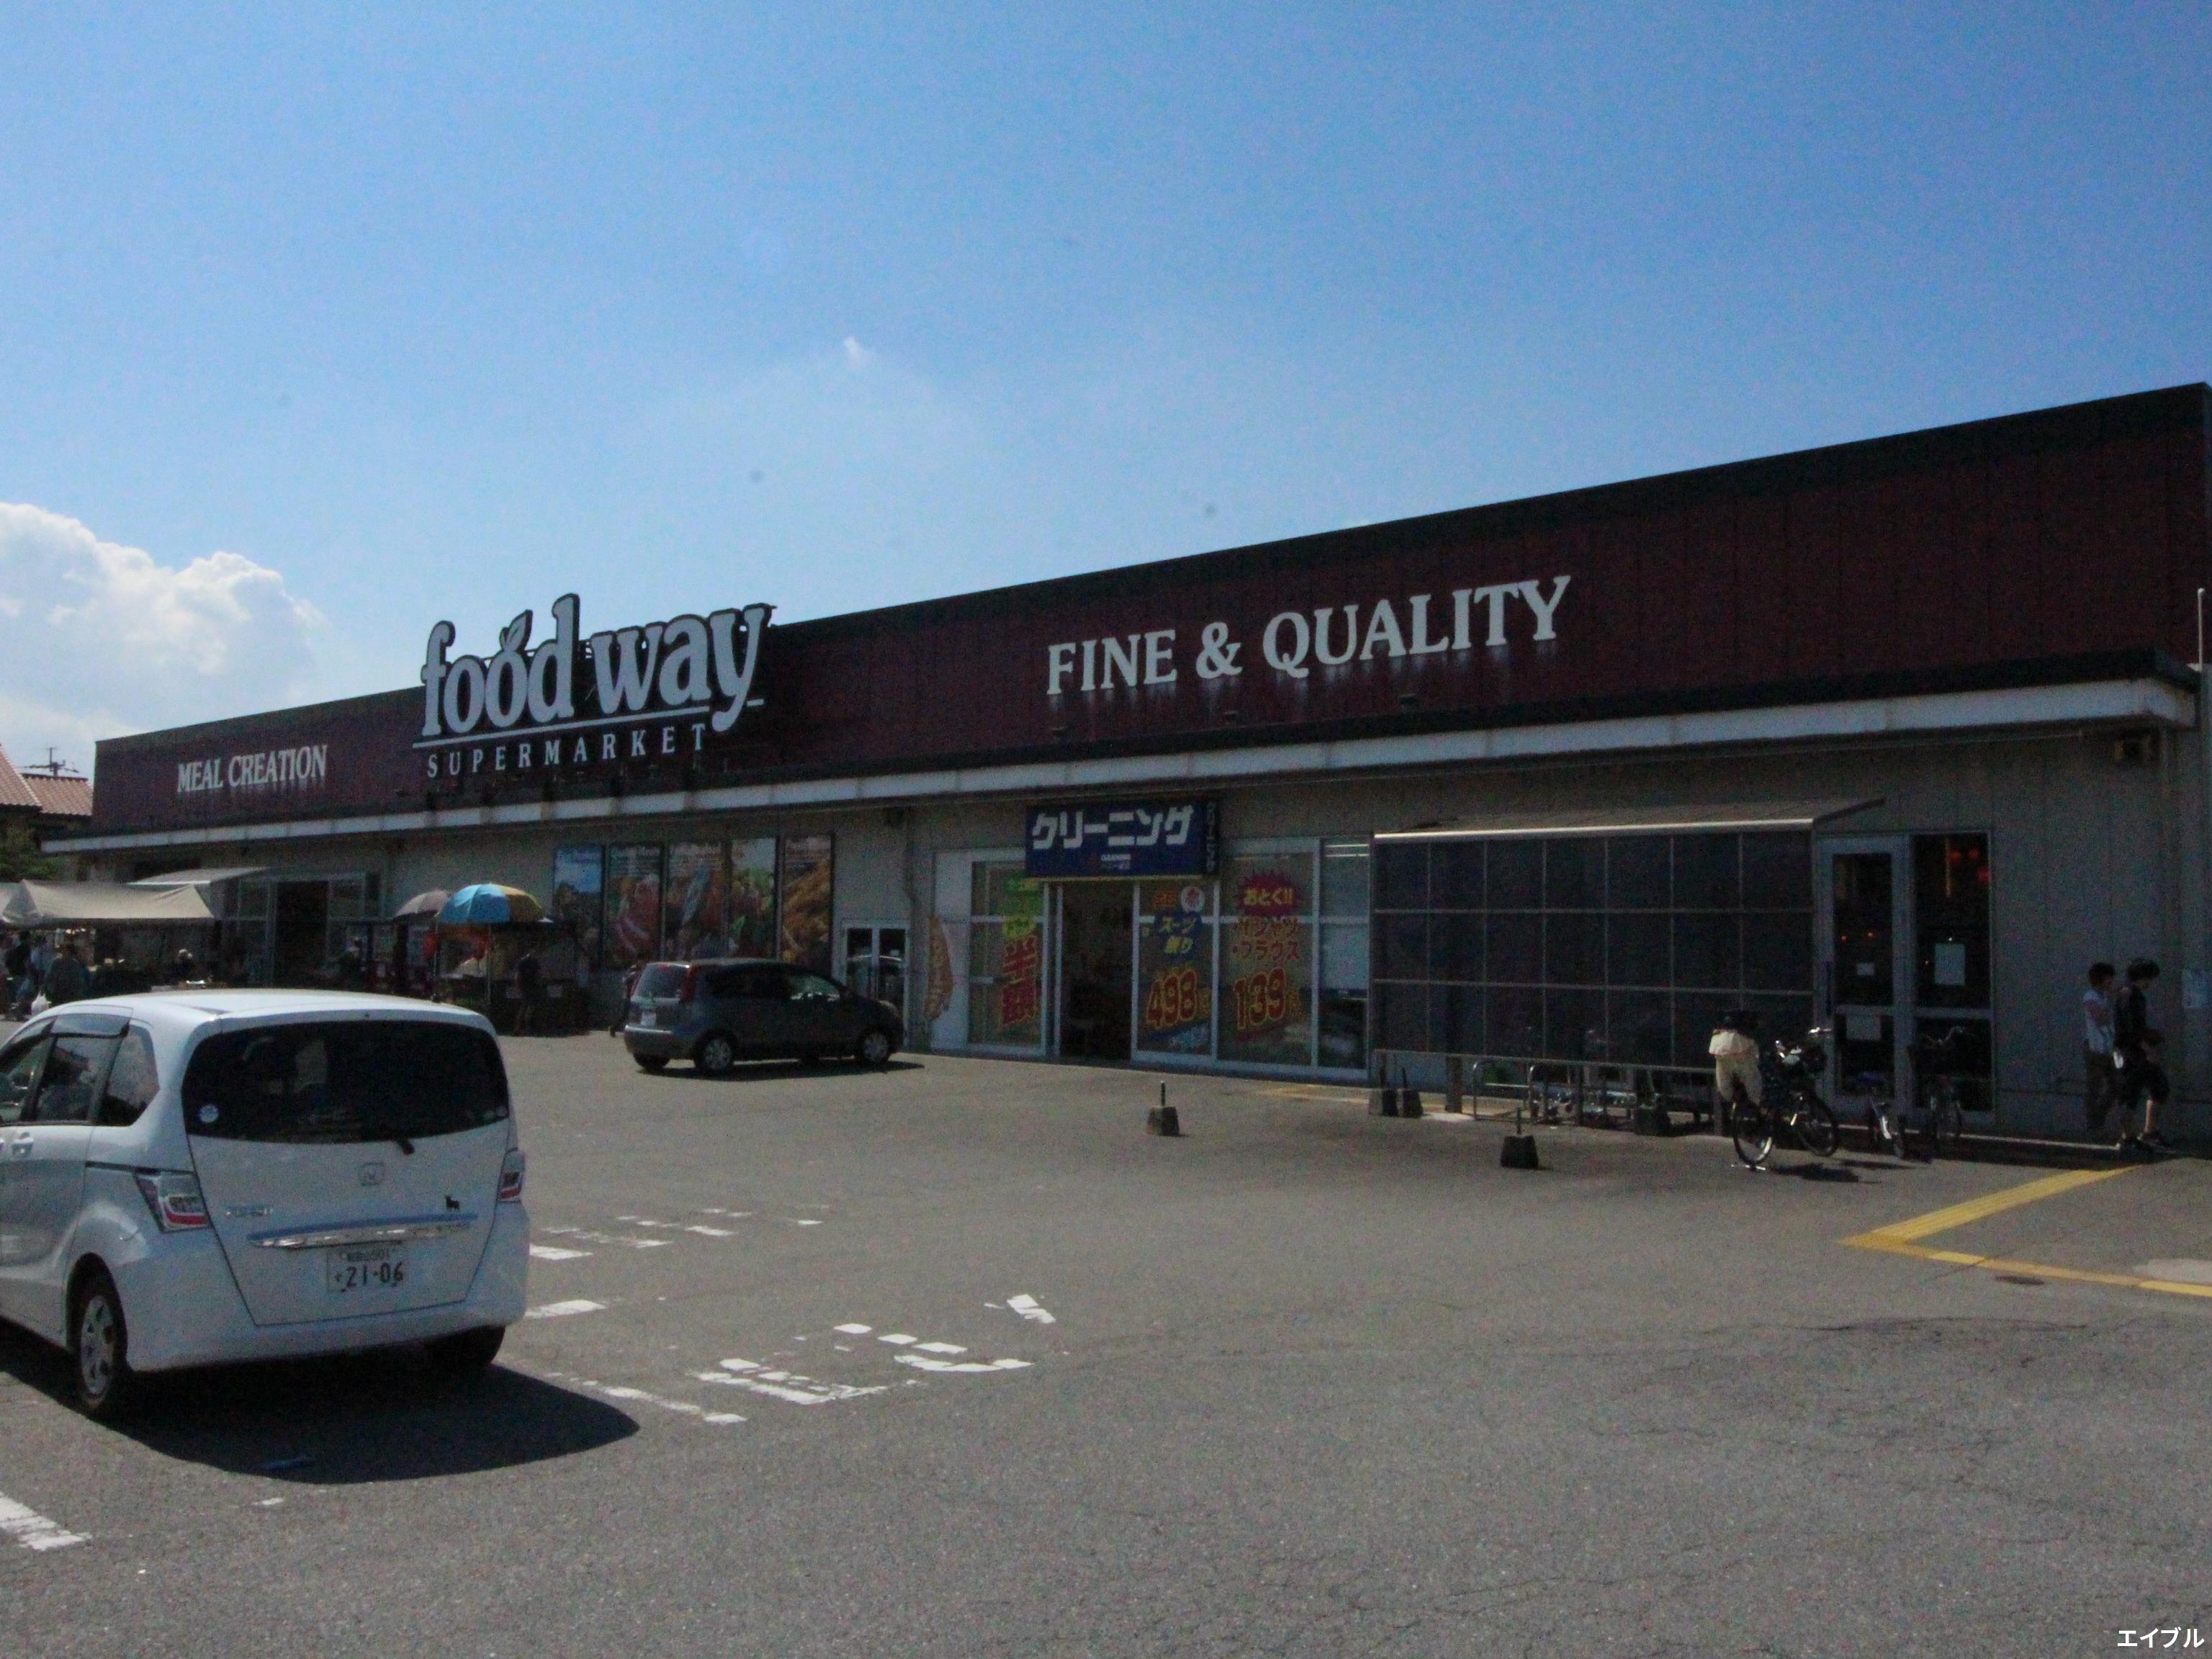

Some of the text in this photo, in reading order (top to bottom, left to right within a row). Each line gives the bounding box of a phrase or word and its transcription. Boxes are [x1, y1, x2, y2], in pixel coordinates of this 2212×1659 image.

[421, 593, 772, 738] food way
[1046, 575, 1573, 696] FINE & QUALITY
[176, 743, 328, 792] MEAL CREATION
[426, 721, 707, 779] SUPERMARKET
[1031, 804, 1195, 851] クリーニング
[1146, 968, 1198, 1030] 498
[1233, 967, 1285, 1030] 139
